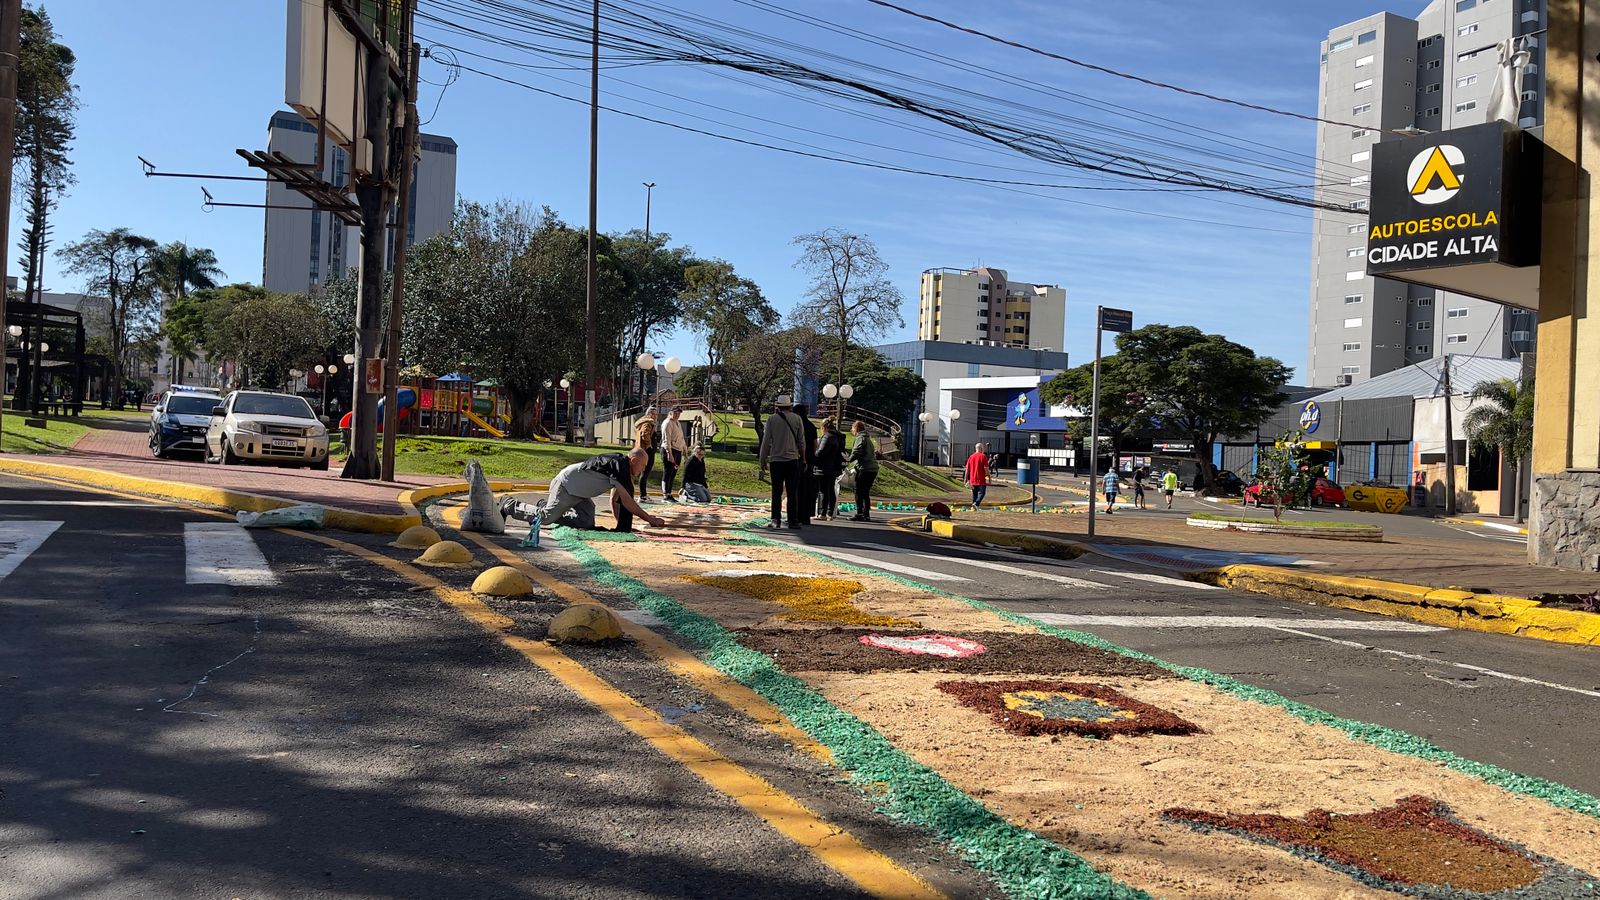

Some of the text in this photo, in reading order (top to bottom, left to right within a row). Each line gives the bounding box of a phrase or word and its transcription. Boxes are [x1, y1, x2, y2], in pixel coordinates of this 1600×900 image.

[1369, 210, 1498, 240] AUTOESCOLA
[1368, 234, 1498, 264] CIDADE ALTA
